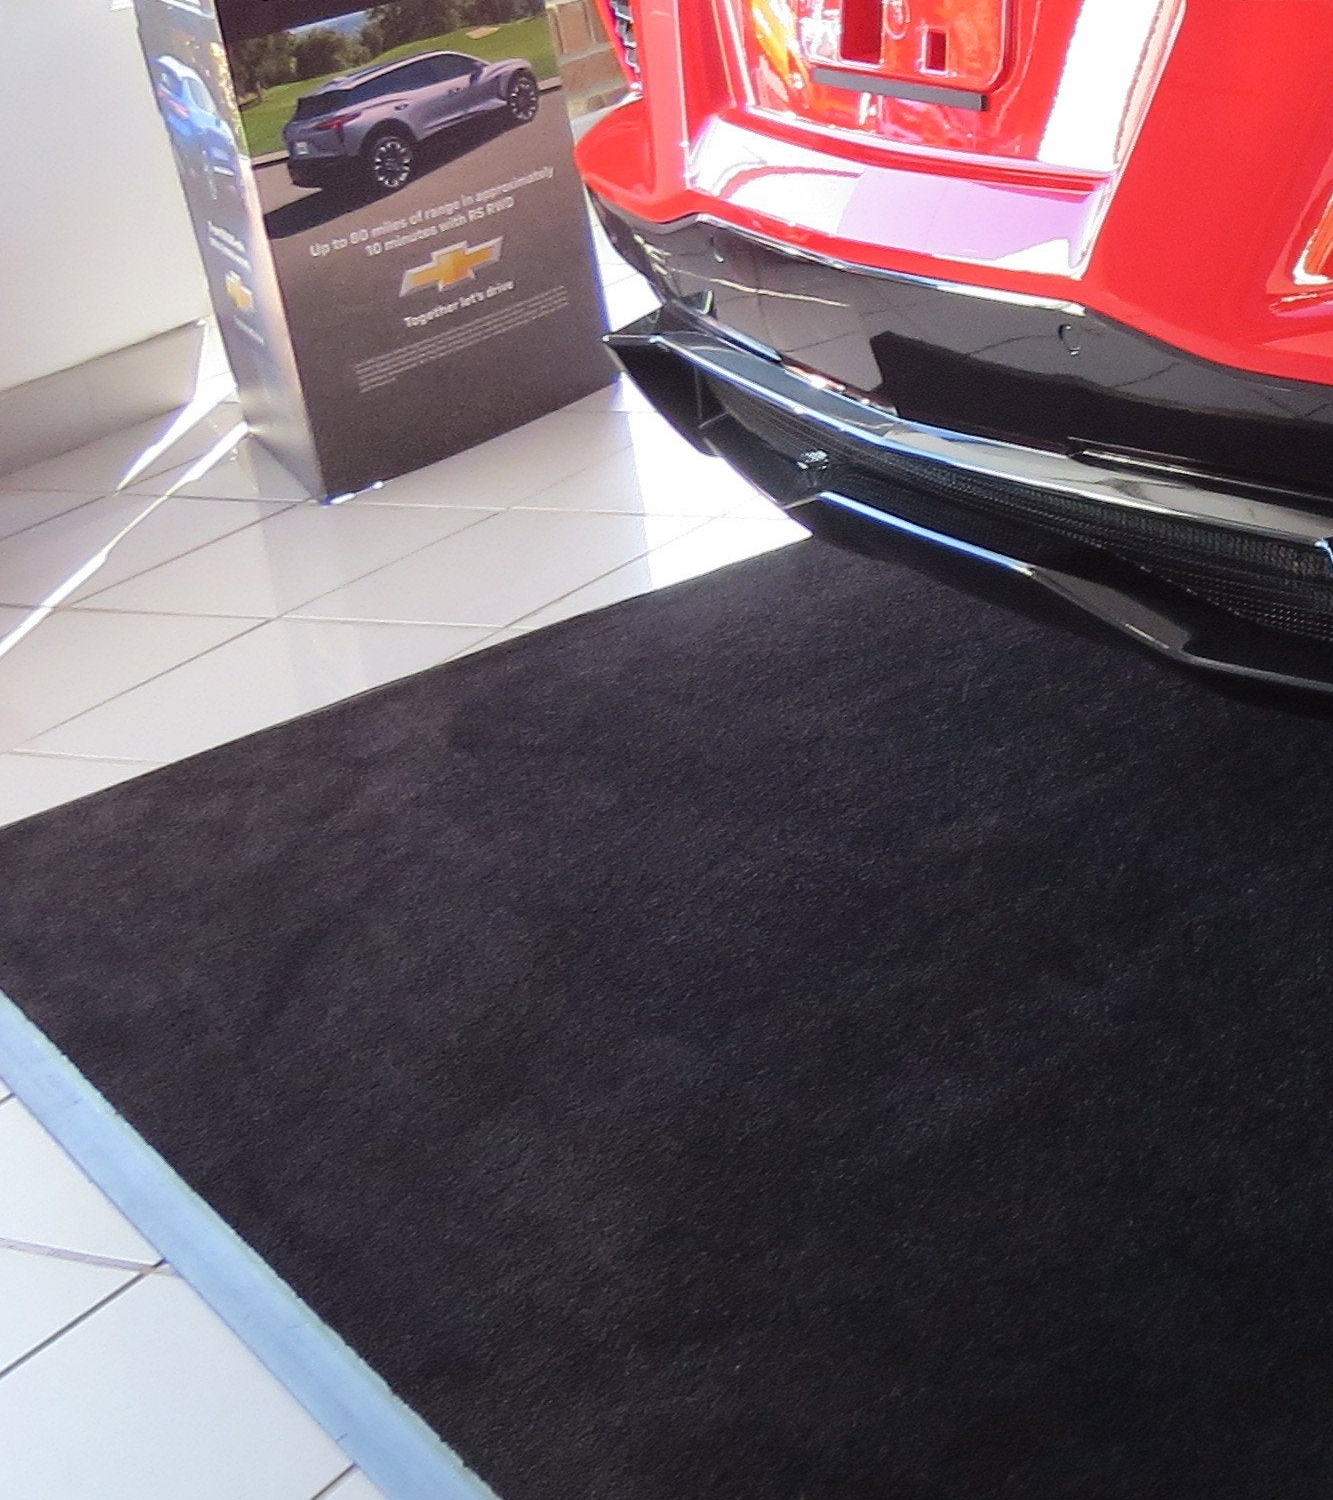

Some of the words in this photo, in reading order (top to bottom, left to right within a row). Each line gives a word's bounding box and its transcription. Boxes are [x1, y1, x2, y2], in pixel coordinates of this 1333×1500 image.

[310, 244, 330, 258] Up
[332, 237, 348, 250] to
[371, 217, 408, 236] miles
[408, 211, 423, 225] of
[424, 201, 461, 220] range
[462, 194, 475, 206] in
[476, 166, 553, 202] approximately
[365, 242, 383, 256] 10
[384, 225, 438, 250] minutes
[438, 215, 468, 232] with
[468, 206, 485, 222] RS
[486, 196, 515, 215] RWD
[403, 301, 459, 328] Together
[459, 291, 485, 308] let's
[486, 280, 515, 298] drive
